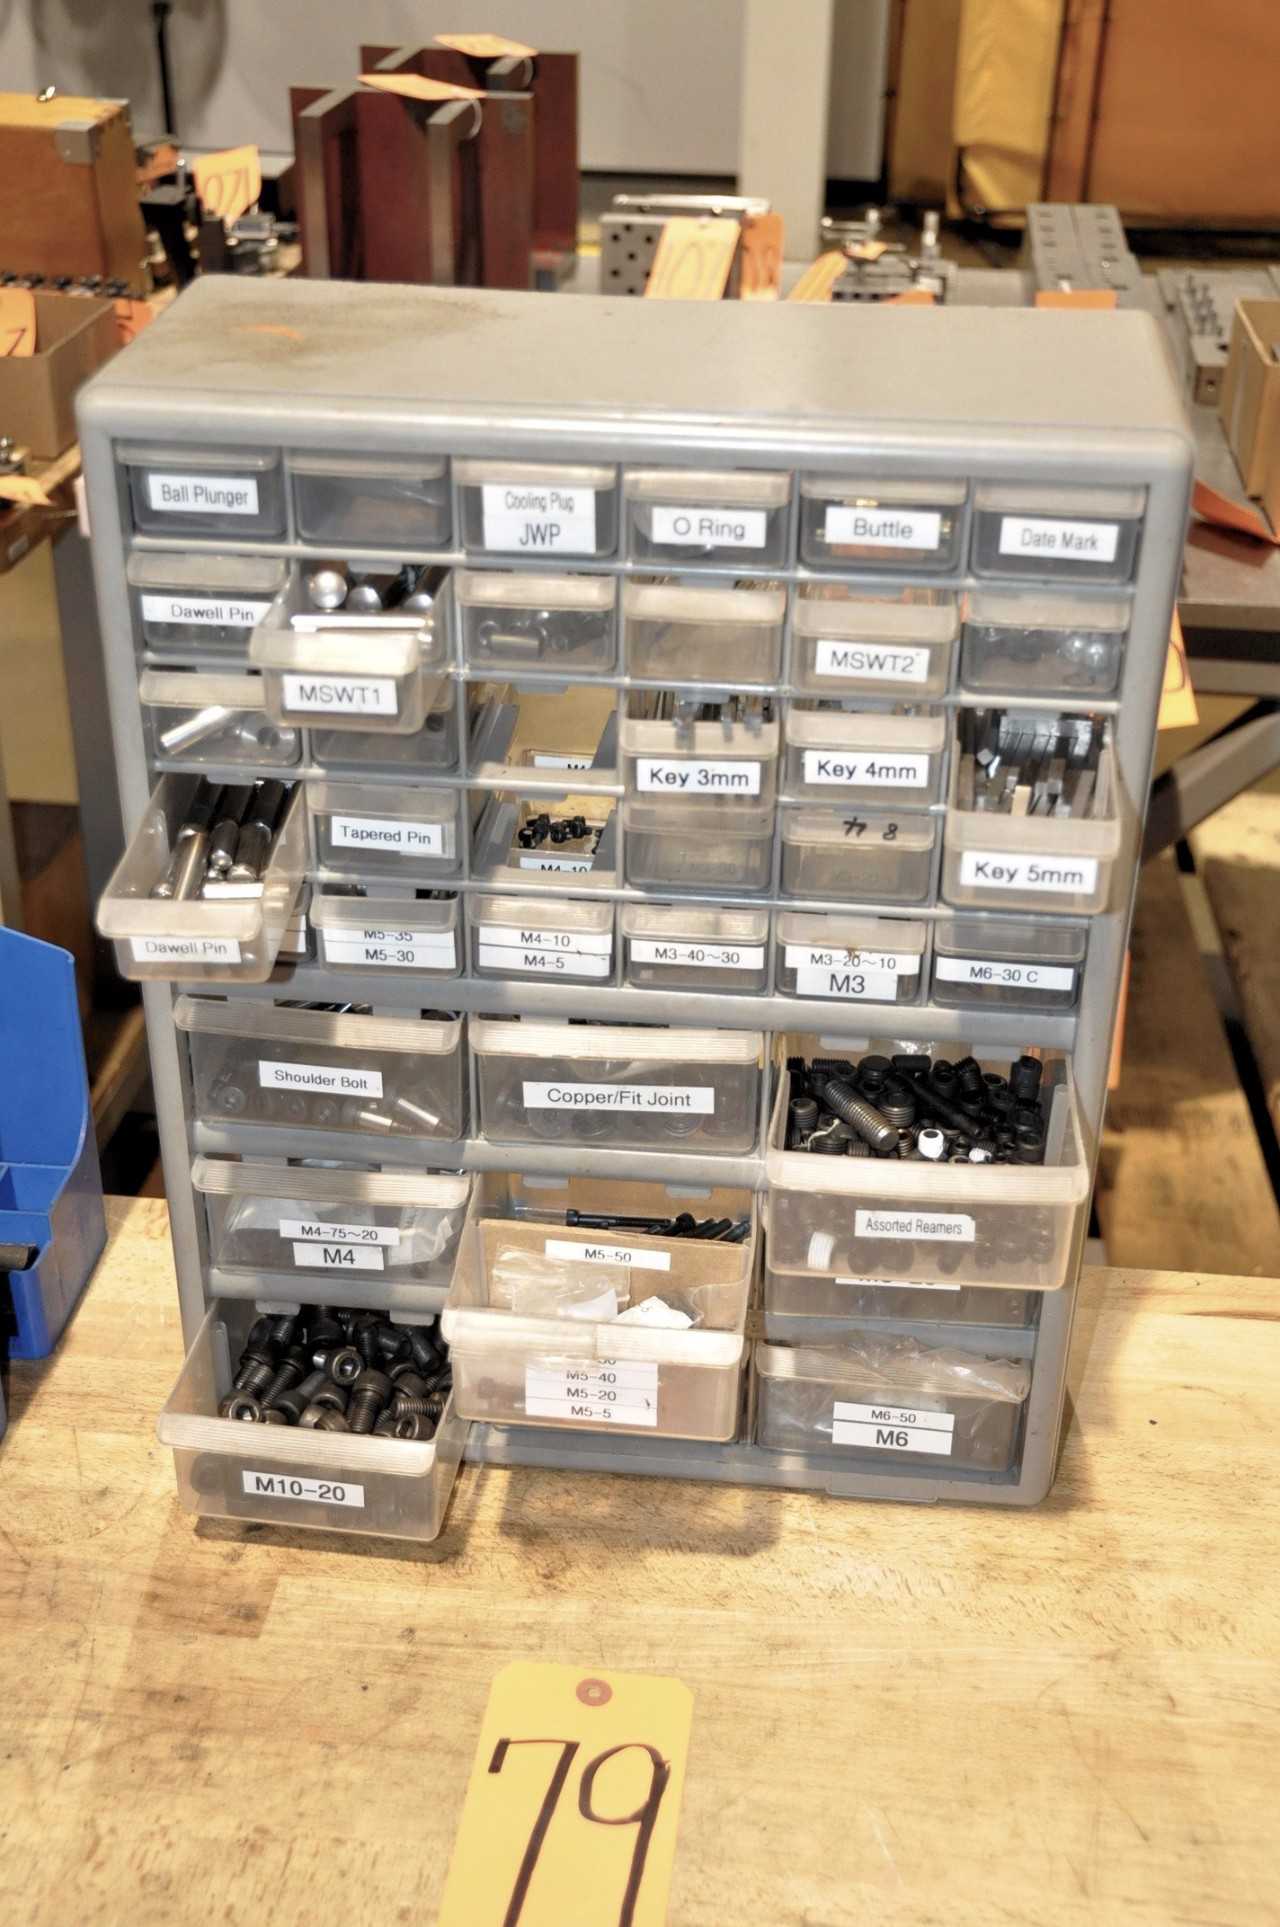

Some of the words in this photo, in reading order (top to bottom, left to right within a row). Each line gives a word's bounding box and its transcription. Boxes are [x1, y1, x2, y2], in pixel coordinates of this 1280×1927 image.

[161, 483, 189, 503] Ball
[193, 486, 249, 507] Plunger
[505, 490, 546, 513] Cooling
[550, 491, 575, 514] Plug
[519, 523, 561, 546] JWP
[673, 518, 692, 536] O
[698, 518, 746, 542] Ring
[853, 518, 913, 539] Buttle
[1021, 527, 1056, 548] Date
[1061, 531, 1098, 551] Mark
[170, 603, 226, 620] Dawell
[229, 606, 255, 622] Pin
[830, 651, 915, 674] MSWT2
[298, 684, 380, 706] MSWT1
[650, 768, 689, 788] Key
[697, 769, 749, 788] 3mm
[817, 760, 857, 780] Key
[866, 762, 917, 780] 4mm
[341, 826, 402, 844] Tapered
[407, 829, 431, 845] Pin
[974, 861, 1019, 883] Key
[1027, 864, 1084, 885] 5mm
[364, 929, 413, 942] M5-35
[520, 931, 570, 947] M4-10
[145, 940, 198, 954] Dawell
[203, 942, 228, 955] Pin
[365, 948, 415, 962] M5-30
[524, 954, 565, 969] M4-5
[829, 972, 866, 994] M3
[970, 966, 1021, 982] M6-30
[1026, 970, 1039, 984] C
[274, 1068, 336, 1087] Shoulder
[341, 1076, 367, 1090] Bolt
[547, 1087, 642, 1105] Copper/Fit
[648, 1091, 691, 1107] Joint
[865, 1216, 912, 1233] Assorted
[916, 1219, 962, 1235] Reamers
[324, 1247, 355, 1265] M4
[585, 1248, 631, 1263] M5-50
[566, 1369, 616, 1384] M5-40
[566, 1386, 617, 1401] M5-20
[571, 1405, 612, 1419] M5-5
[871, 1409, 917, 1424] M6-50
[876, 1428, 908, 1447] M6
[255, 1476, 346, 1502] M10-20
[488, 1738, 671, 1927] 79
